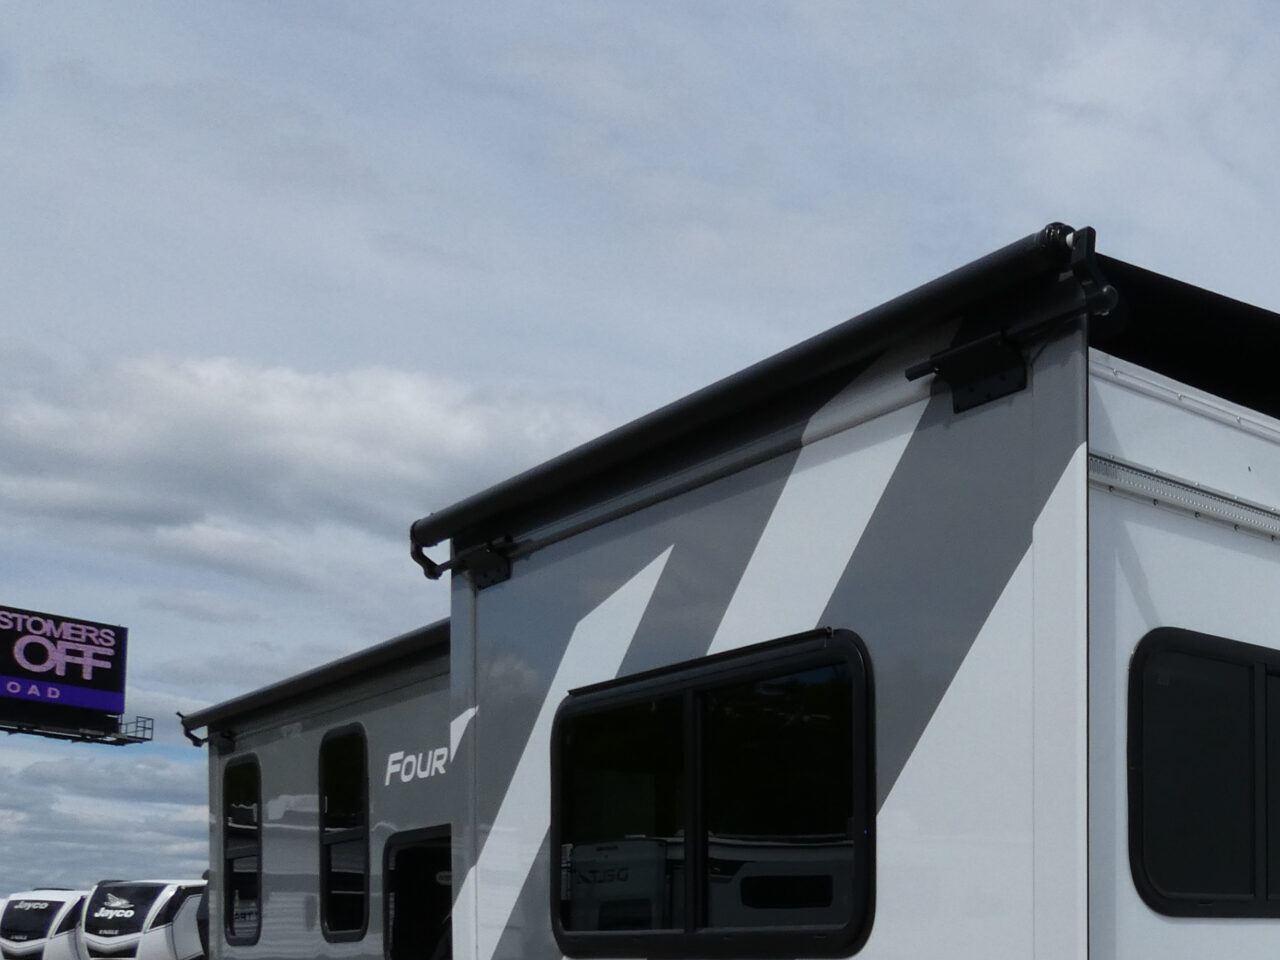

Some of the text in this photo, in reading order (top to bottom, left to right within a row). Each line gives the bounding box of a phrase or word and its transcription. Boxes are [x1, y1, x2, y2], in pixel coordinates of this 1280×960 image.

[13, 634, 115, 680] OFF
[385, 747, 448, 786] FOUR
[14, 901, 49, 911] Jayco
[94, 907, 135, 919] Jayco
